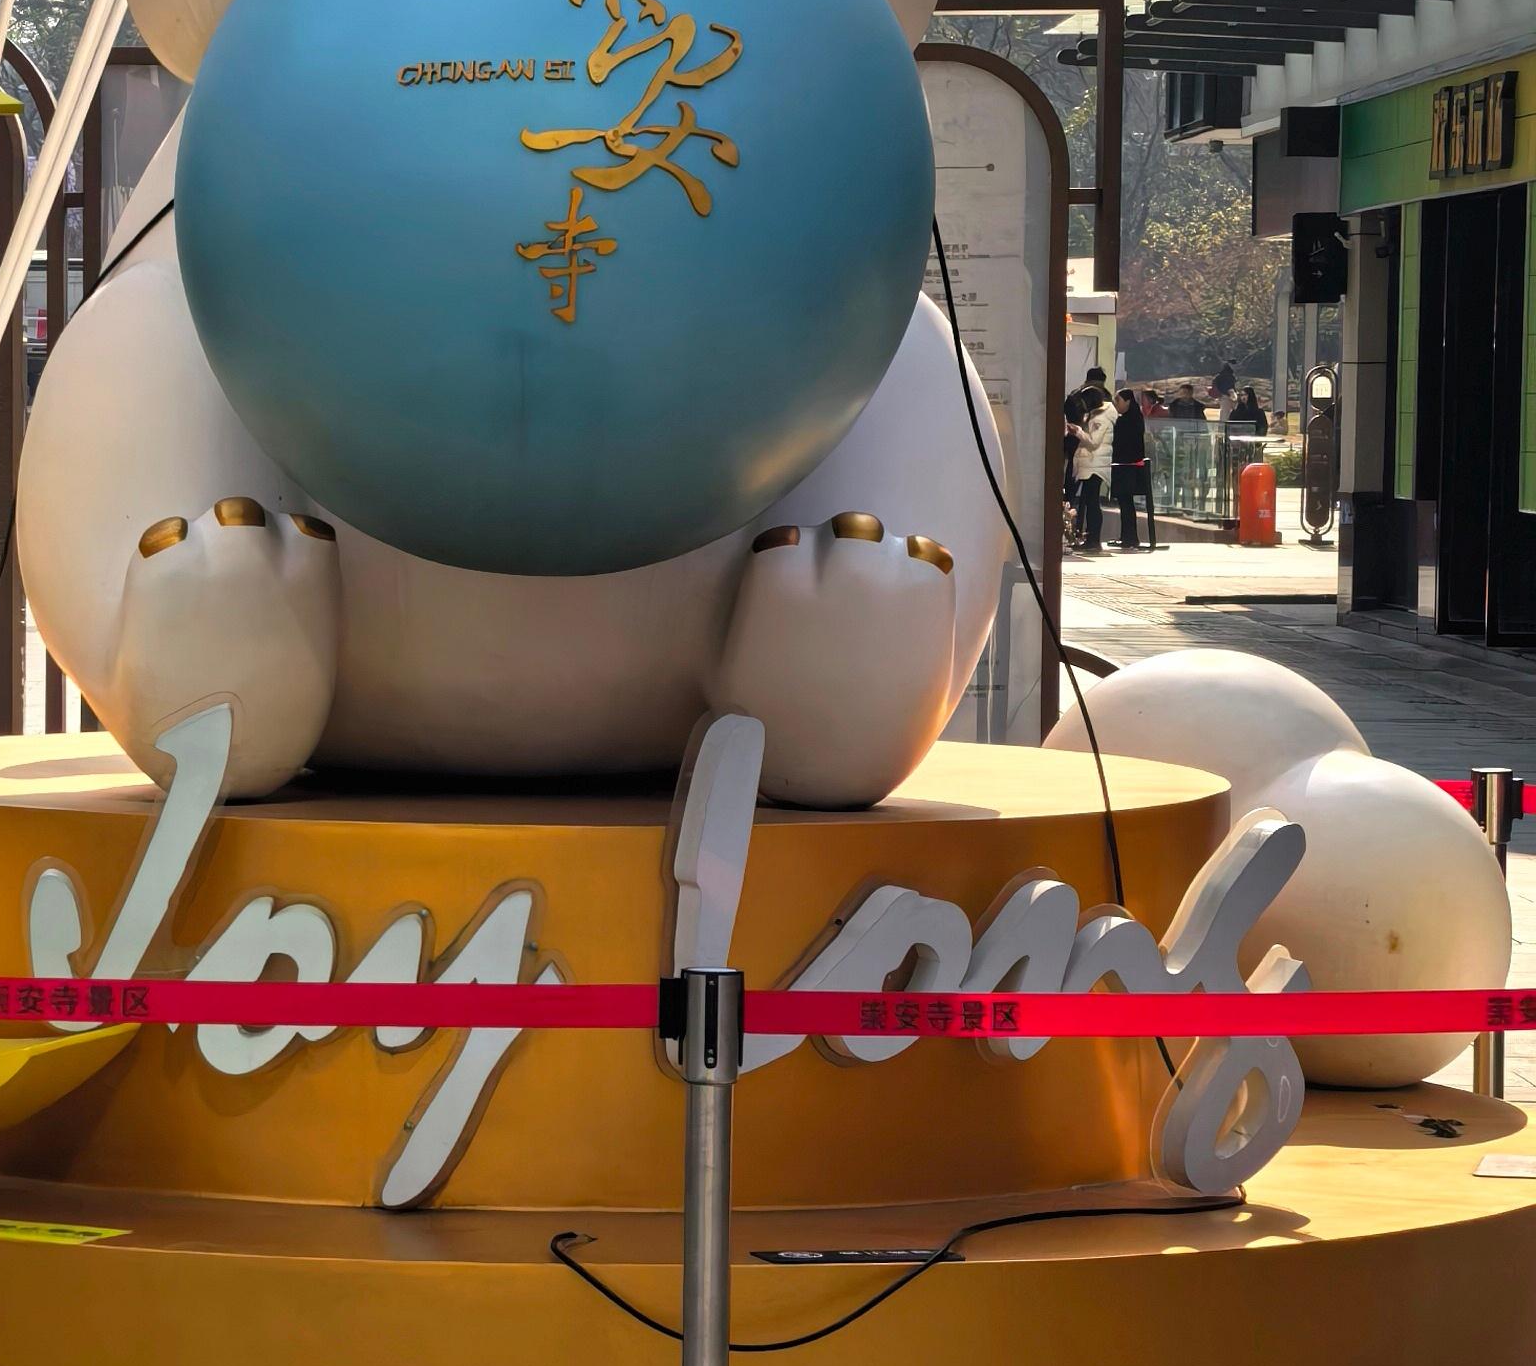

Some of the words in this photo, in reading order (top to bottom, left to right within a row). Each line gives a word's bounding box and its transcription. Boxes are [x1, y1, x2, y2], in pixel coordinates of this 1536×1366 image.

[397, 59, 535, 86] CHONGAN
[544, 60, 576, 81] SI
[29, 703, 565, 1208] Joy
[665, 713, 1310, 1196] Long
[860, 1001, 1020, 1031] 崇安寺景区
